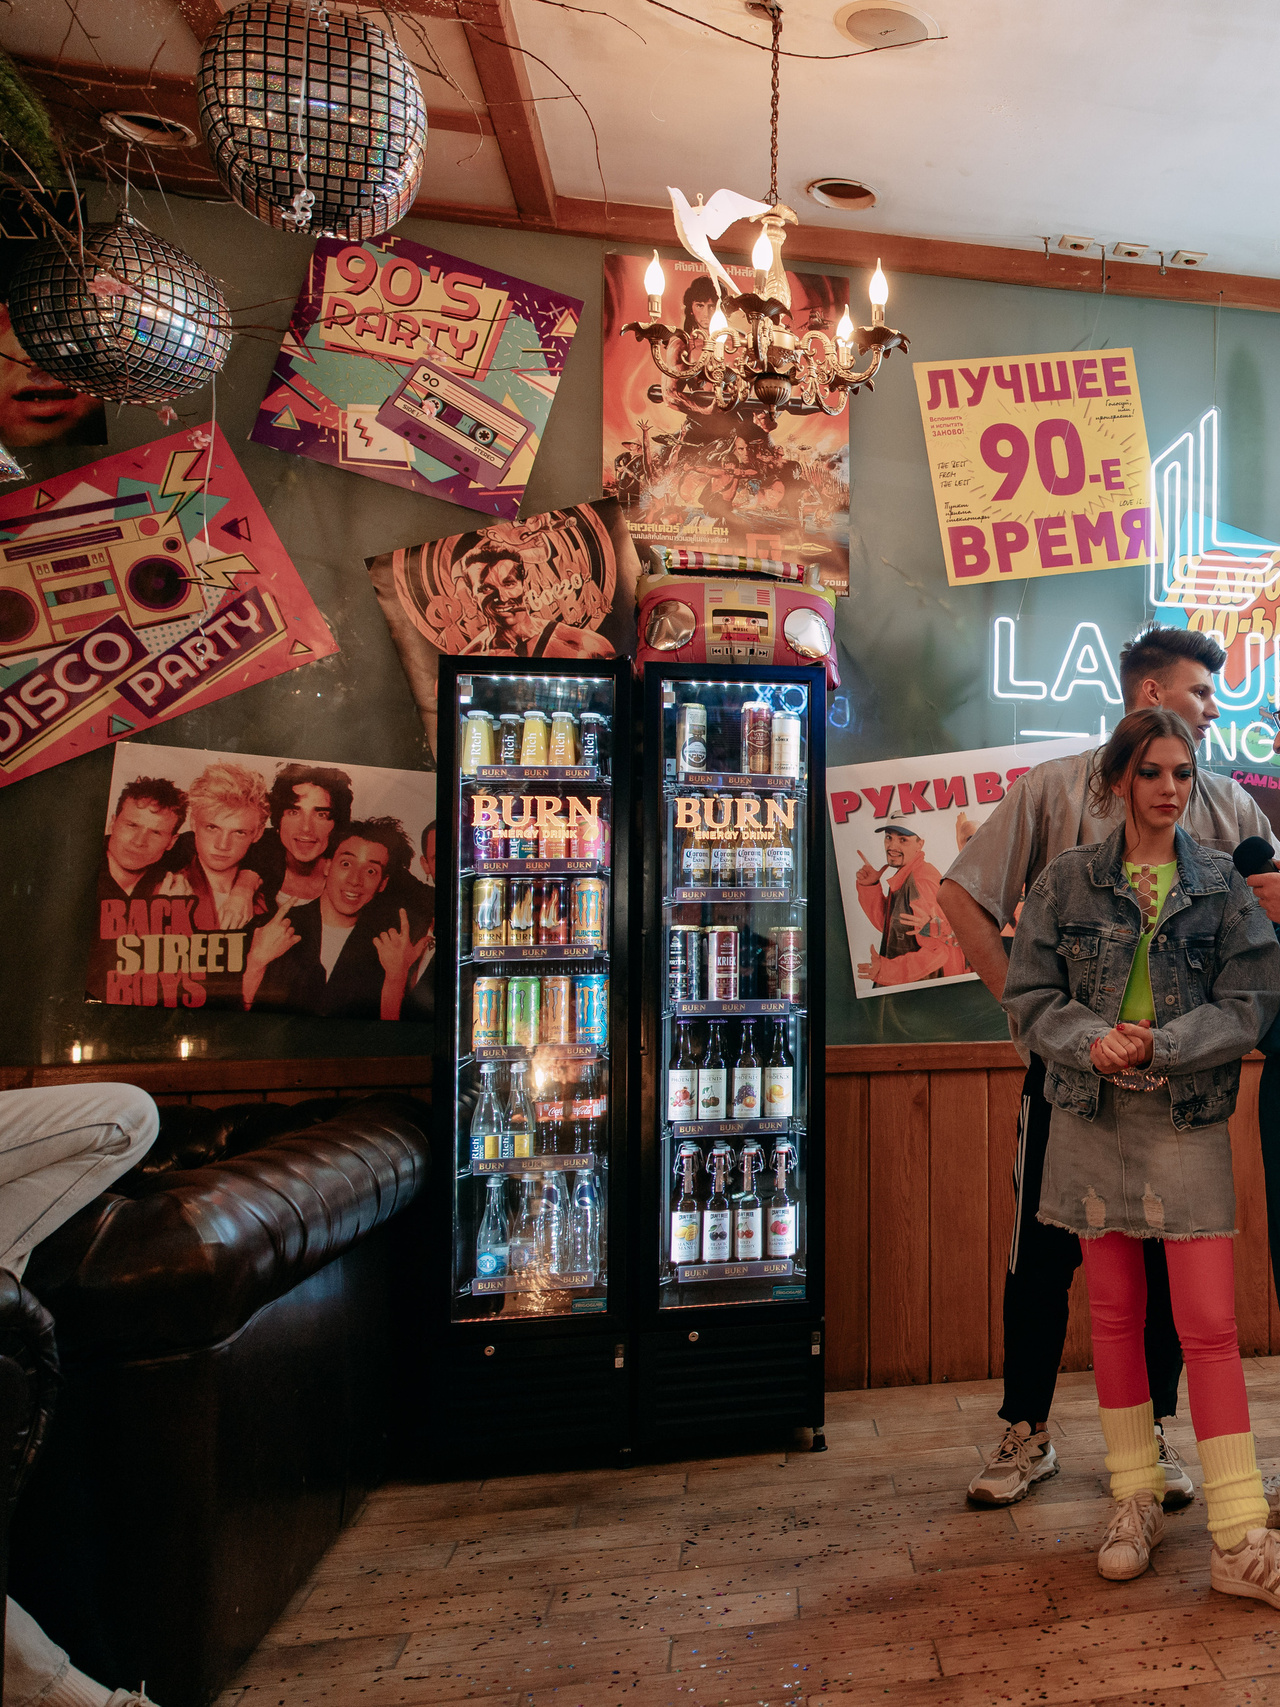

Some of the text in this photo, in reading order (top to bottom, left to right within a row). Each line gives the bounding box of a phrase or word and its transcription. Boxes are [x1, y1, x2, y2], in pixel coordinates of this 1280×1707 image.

[336, 246, 484, 322] 90'S
[324, 296, 479, 360] PARTY
[422, 372, 440, 388] 90
[926, 356, 1132, 411] ЛУЧШЕЕ
[402, 403, 416, 416] SIDE
[473, 446, 496, 462] STEREO
[947, 507, 1158, 579] ВРЕМЯ
[127, 600, 262, 707] PARTY
[0, 632, 131, 751] DISCO
[470, 731, 482, 756] Rich
[503, 734, 515, 758] Rich
[526, 732, 537, 756] Rich
[555, 732, 566, 756] Rich
[584, 732, 595, 756] Rich
[482, 768, 507, 776] BURN
[728, 776, 753, 784] BURN
[471, 795, 602, 827] BURN
[830, 775, 969, 825] РУКИ
[674, 798, 797, 829] BURN
[492, 829, 578, 839] ENERGY DRINK
[695, 831, 775, 840] ENERGY DRINK
[525, 861, 551, 869] BURN
[566, 861, 592, 869] BURN
[761, 890, 785, 898] BURN
[101, 898, 196, 940] BACK
[116, 933, 247, 976] STREET
[717, 956, 737, 966] KRIEK
[106, 970, 207, 1009] BOYS
[682, 1004, 706, 1012] BURN
[722, 1003, 746, 1011] BURN
[482, 1049, 508, 1057] BURN
[679, 1122, 783, 1133] BURN BURN BURN
[479, 1162, 505, 1170] BURN
[563, 1158, 589, 1167] BURN
[684, 1263, 787, 1278] BURN BURN BURN
[477, 1281, 504, 1290] BURN
